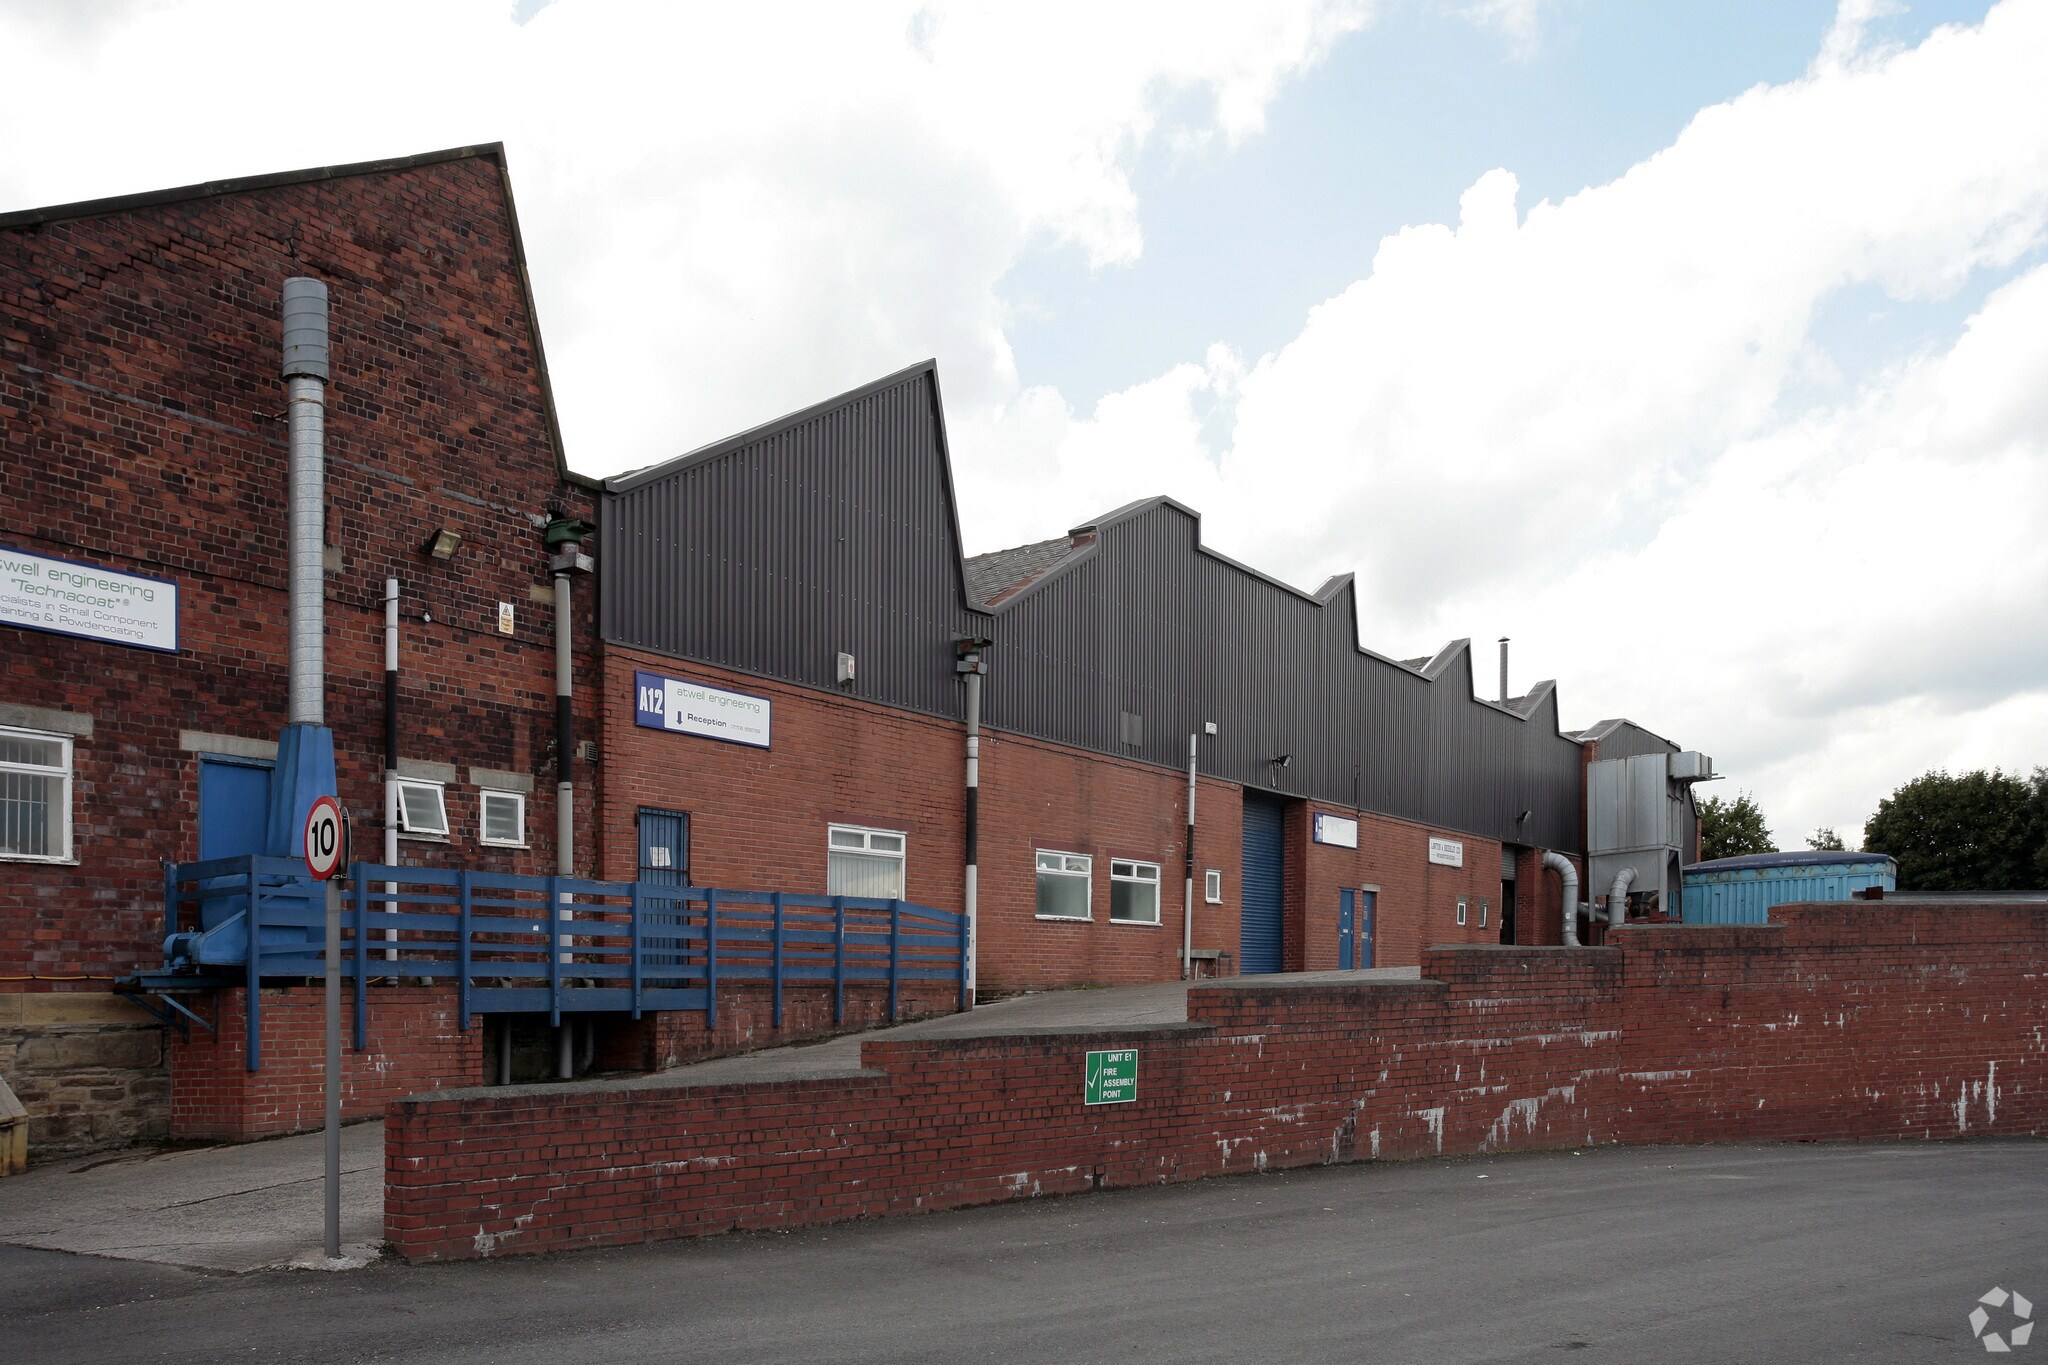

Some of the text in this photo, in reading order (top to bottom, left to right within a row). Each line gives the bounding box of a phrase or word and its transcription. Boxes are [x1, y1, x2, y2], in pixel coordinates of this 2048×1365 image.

[48, 569, 154, 601] engineering
[0, 604, 145, 639] ainting & Powdercoating.
[46, 602, 55, 610] in
[60, 604, 90, 617] Small
[94, 611, 159, 630] Component
[639, 686, 663, 715] A12
[677, 687, 760, 713] atwell engineering
[687, 713, 727, 728] Reception
[312, 818, 335, 857] 10
[1108, 1053, 1132, 1062] UNIT E1
[1103, 1068, 1117, 1076] FIRE
[1103, 1078, 1134, 1087] ASSEMBLY
[1103, 1090, 1121, 1099] POINT
